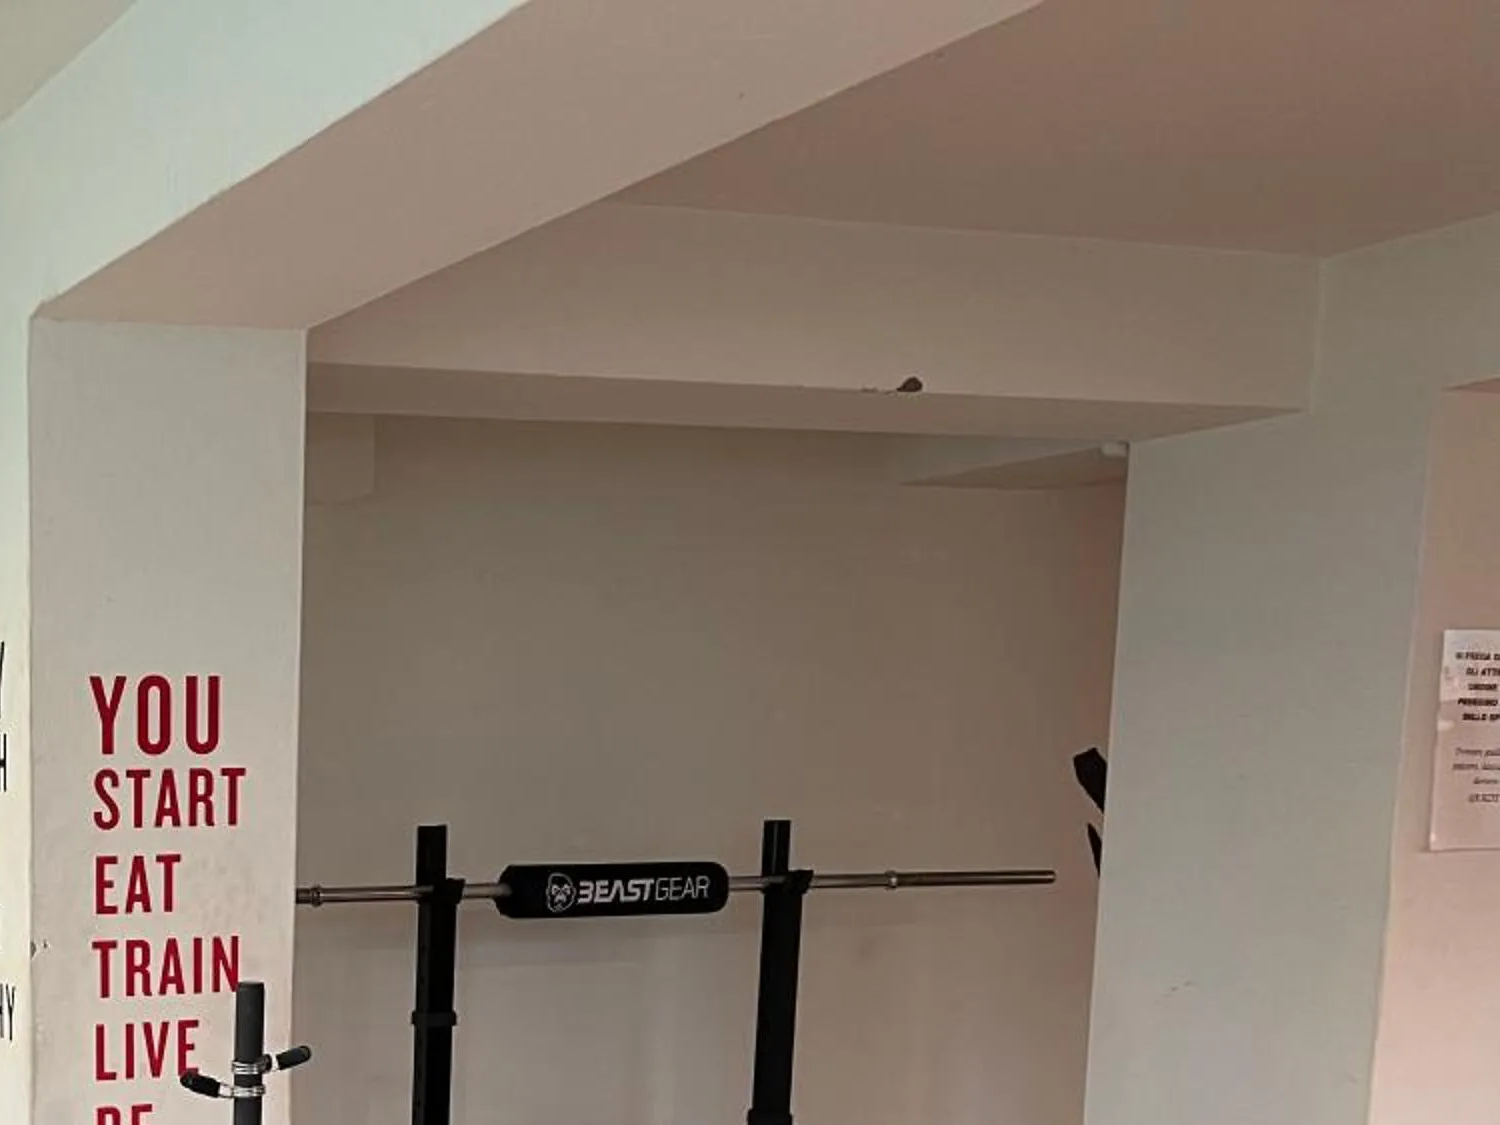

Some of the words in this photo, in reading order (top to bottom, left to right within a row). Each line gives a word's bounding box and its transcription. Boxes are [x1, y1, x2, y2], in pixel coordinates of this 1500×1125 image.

[90, 675, 220, 755] YOU
[93, 767, 246, 830] START
[96, 854, 181, 915] EAT
[92, 936, 239, 998] TRAIN
[96, 1019, 199, 1081] LIVE
